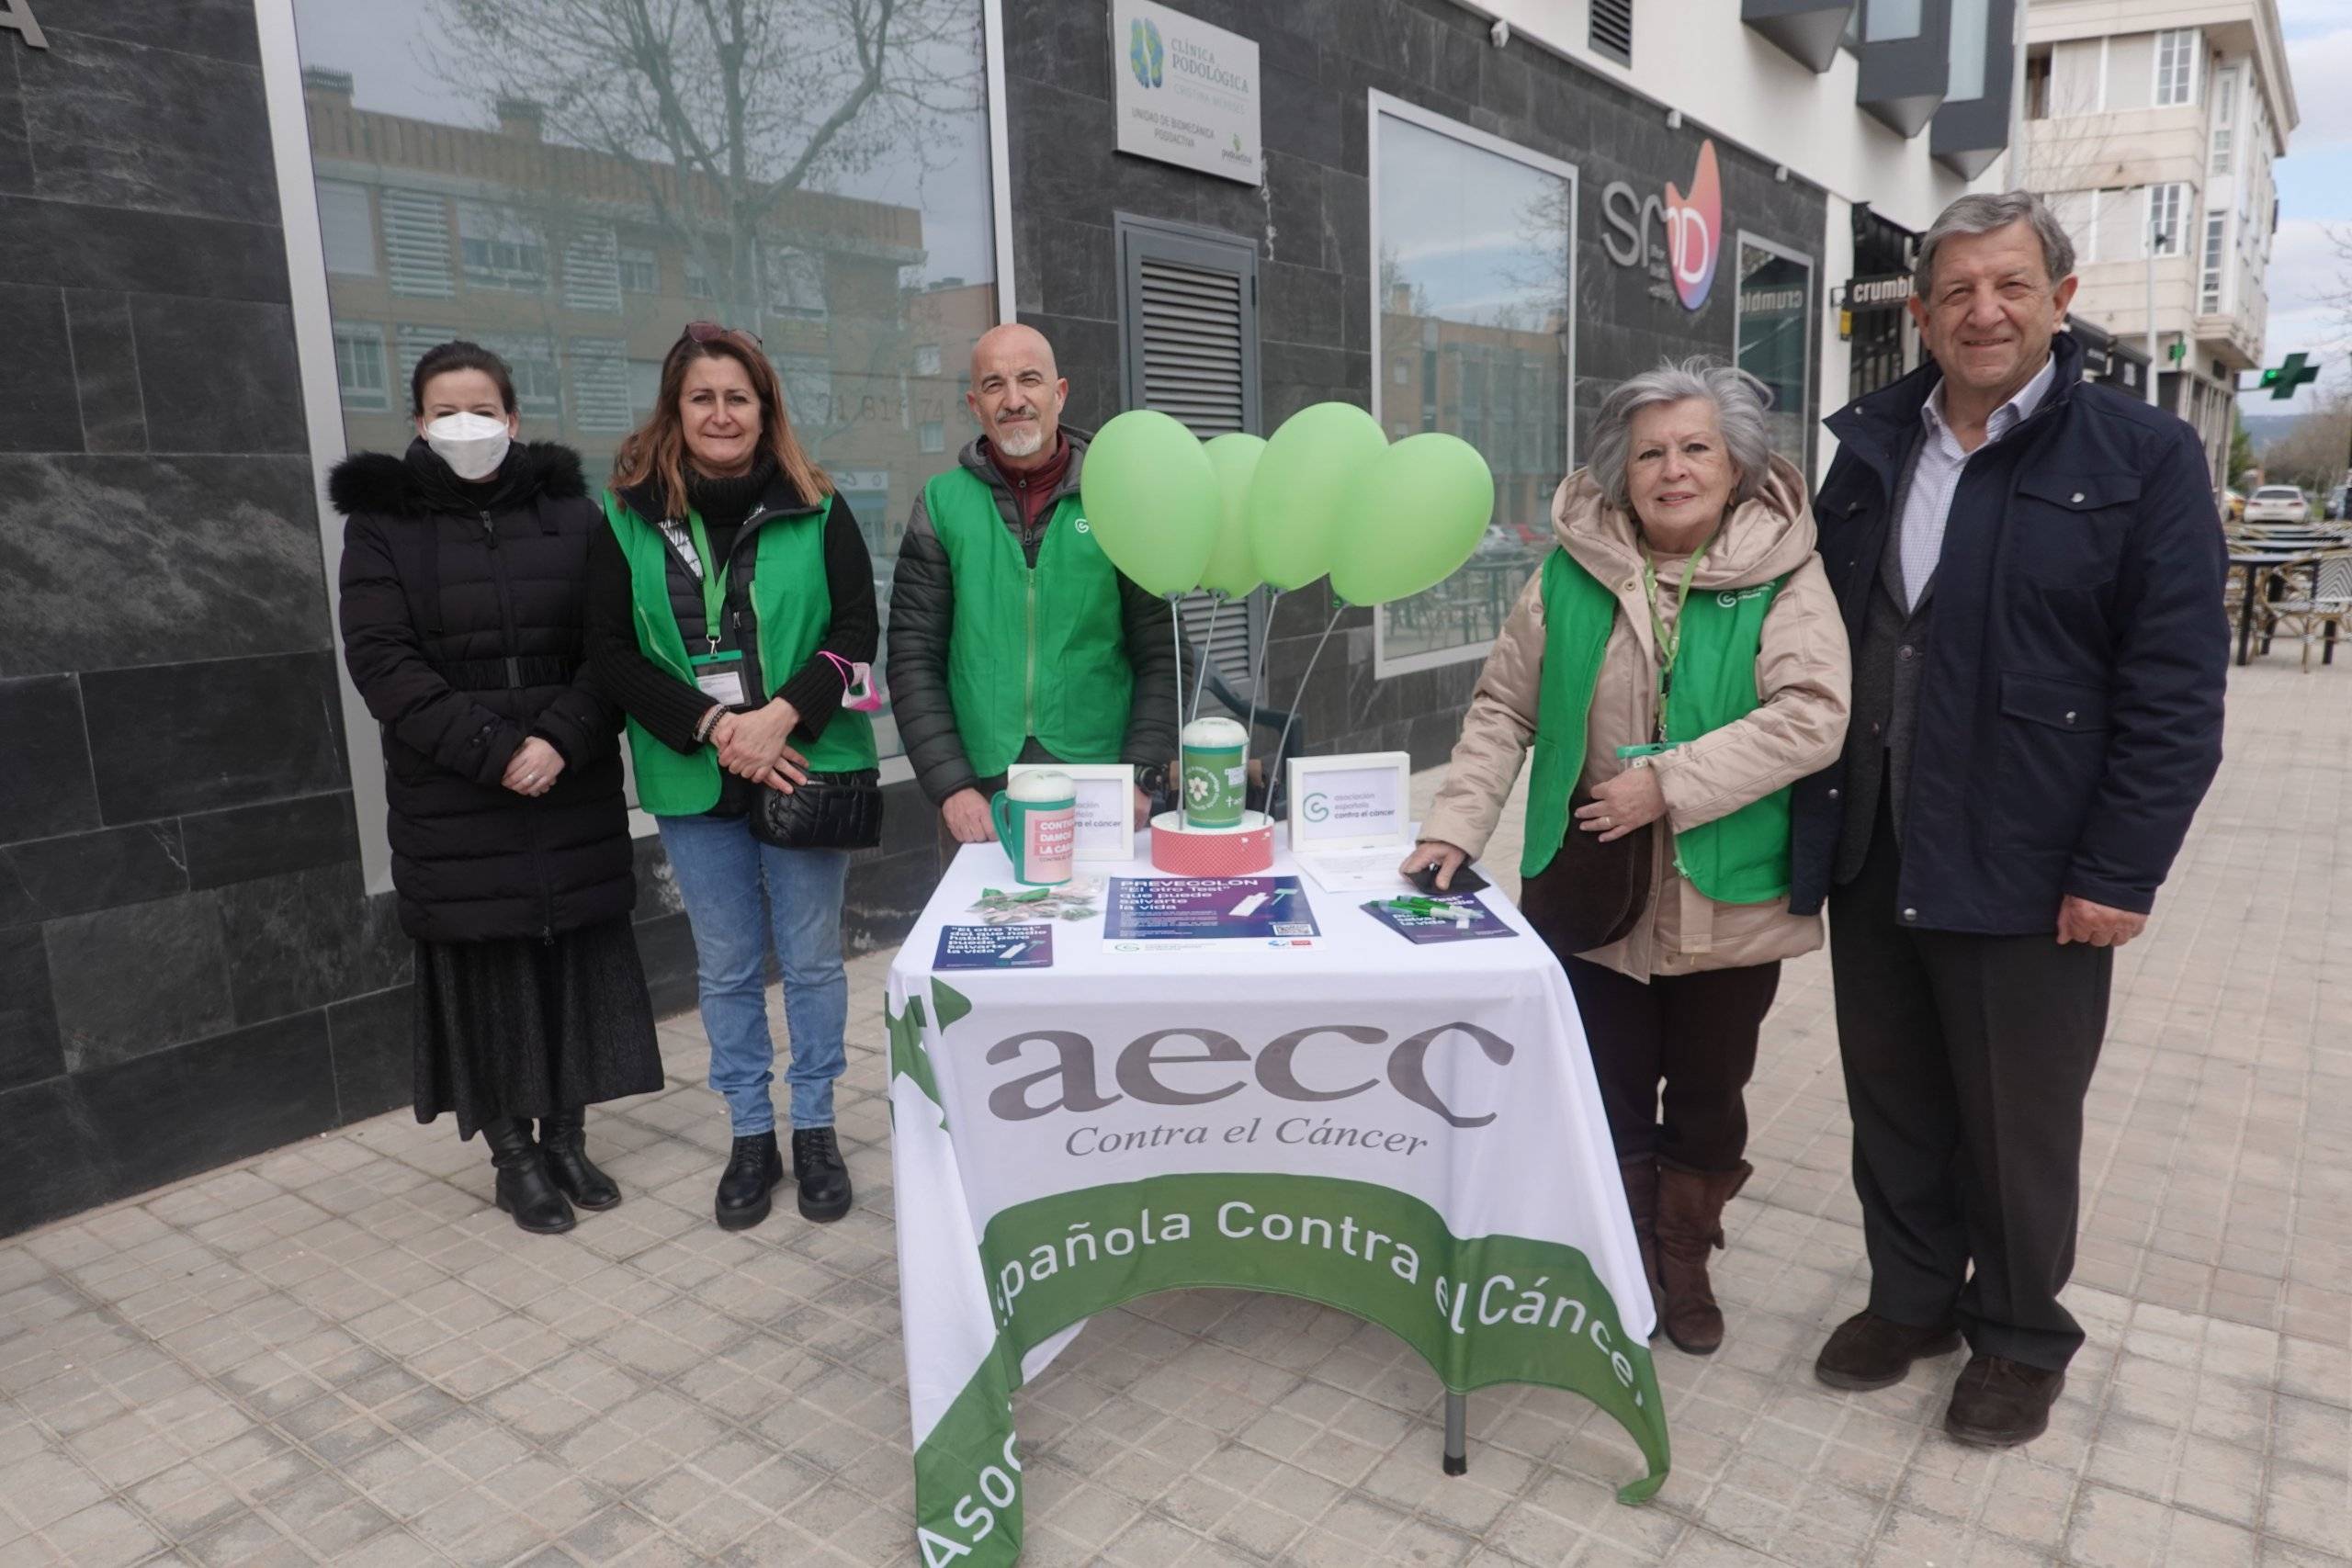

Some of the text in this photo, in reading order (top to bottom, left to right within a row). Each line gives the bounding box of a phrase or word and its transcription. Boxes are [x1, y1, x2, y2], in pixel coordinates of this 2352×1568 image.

[1170, 38, 1216, 63] CLÍNICA
[1172, 54, 1249, 93] PODOLÓGICA
[1160, 114, 1170, 127] DE
[1853, 275, 1917, 303] crumbl
[1039, 846, 1053, 854] LA
[986, 1021, 1515, 1128] aecc
[1066, 1117, 1429, 1156] Contra el Cáncer
[1217, 1201, 1419, 1284] Contra
[1435, 1276, 1467, 1335] el
[1478, 1275, 1643, 1406] Cánce
